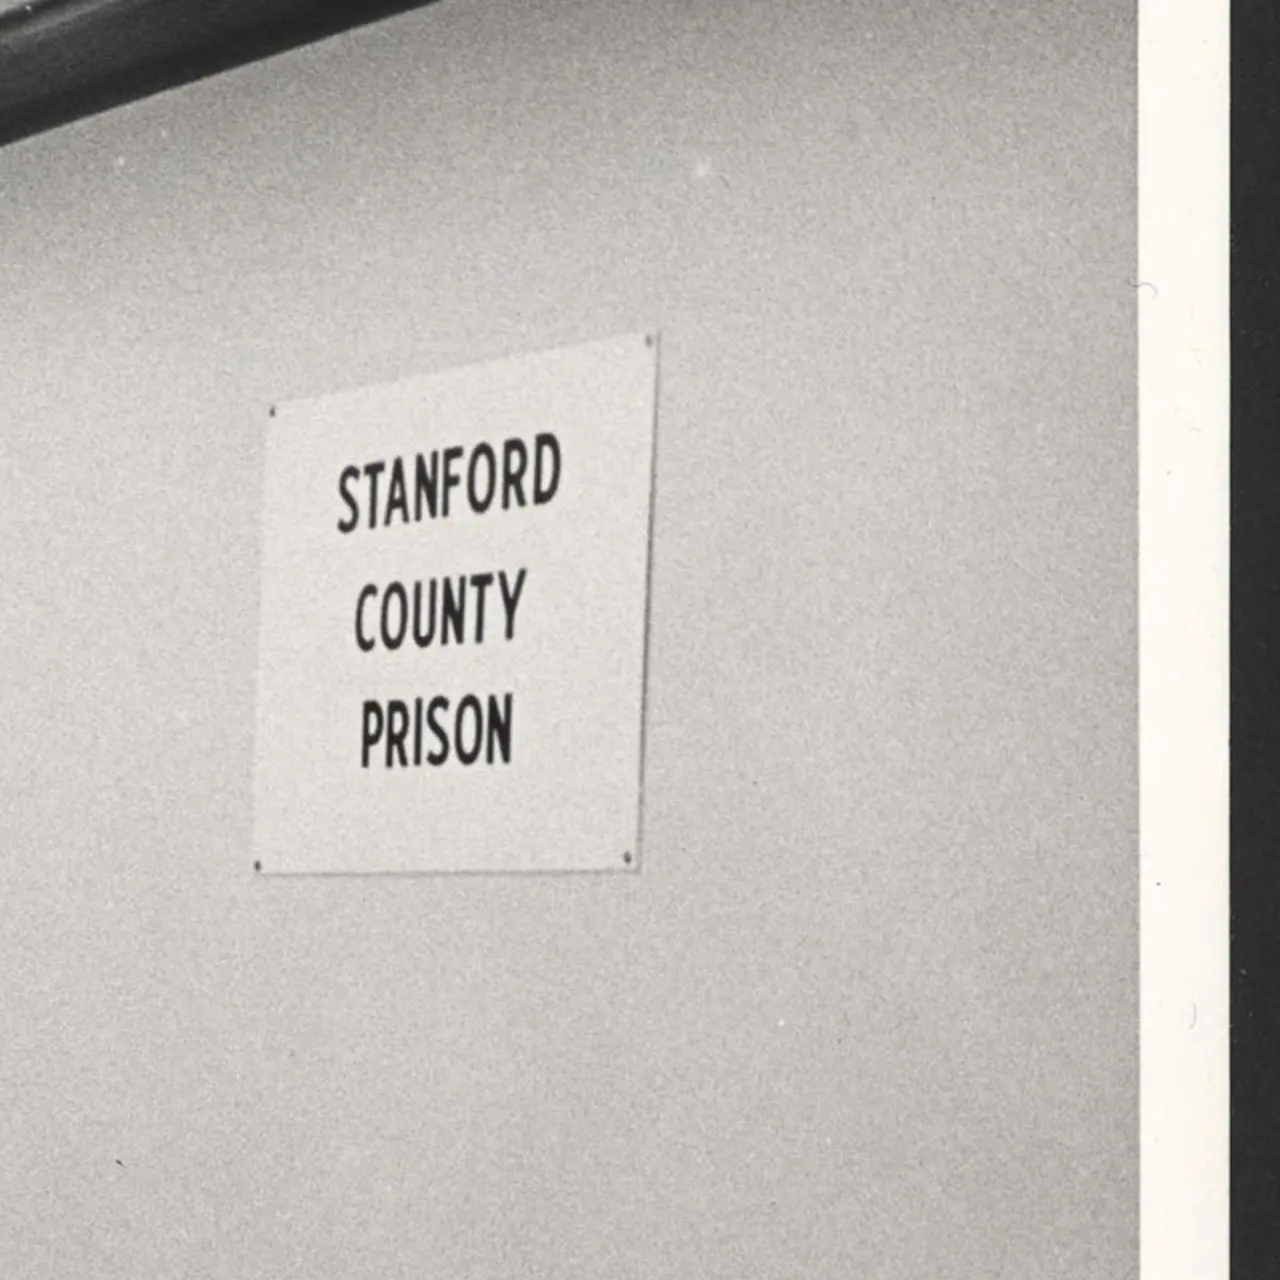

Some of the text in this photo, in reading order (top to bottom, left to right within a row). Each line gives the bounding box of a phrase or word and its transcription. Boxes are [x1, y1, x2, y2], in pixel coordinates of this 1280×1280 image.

[336, 432, 562, 534] STANFORD
[354, 567, 528, 653] COUNTY
[360, 692, 514, 769] PRISON
